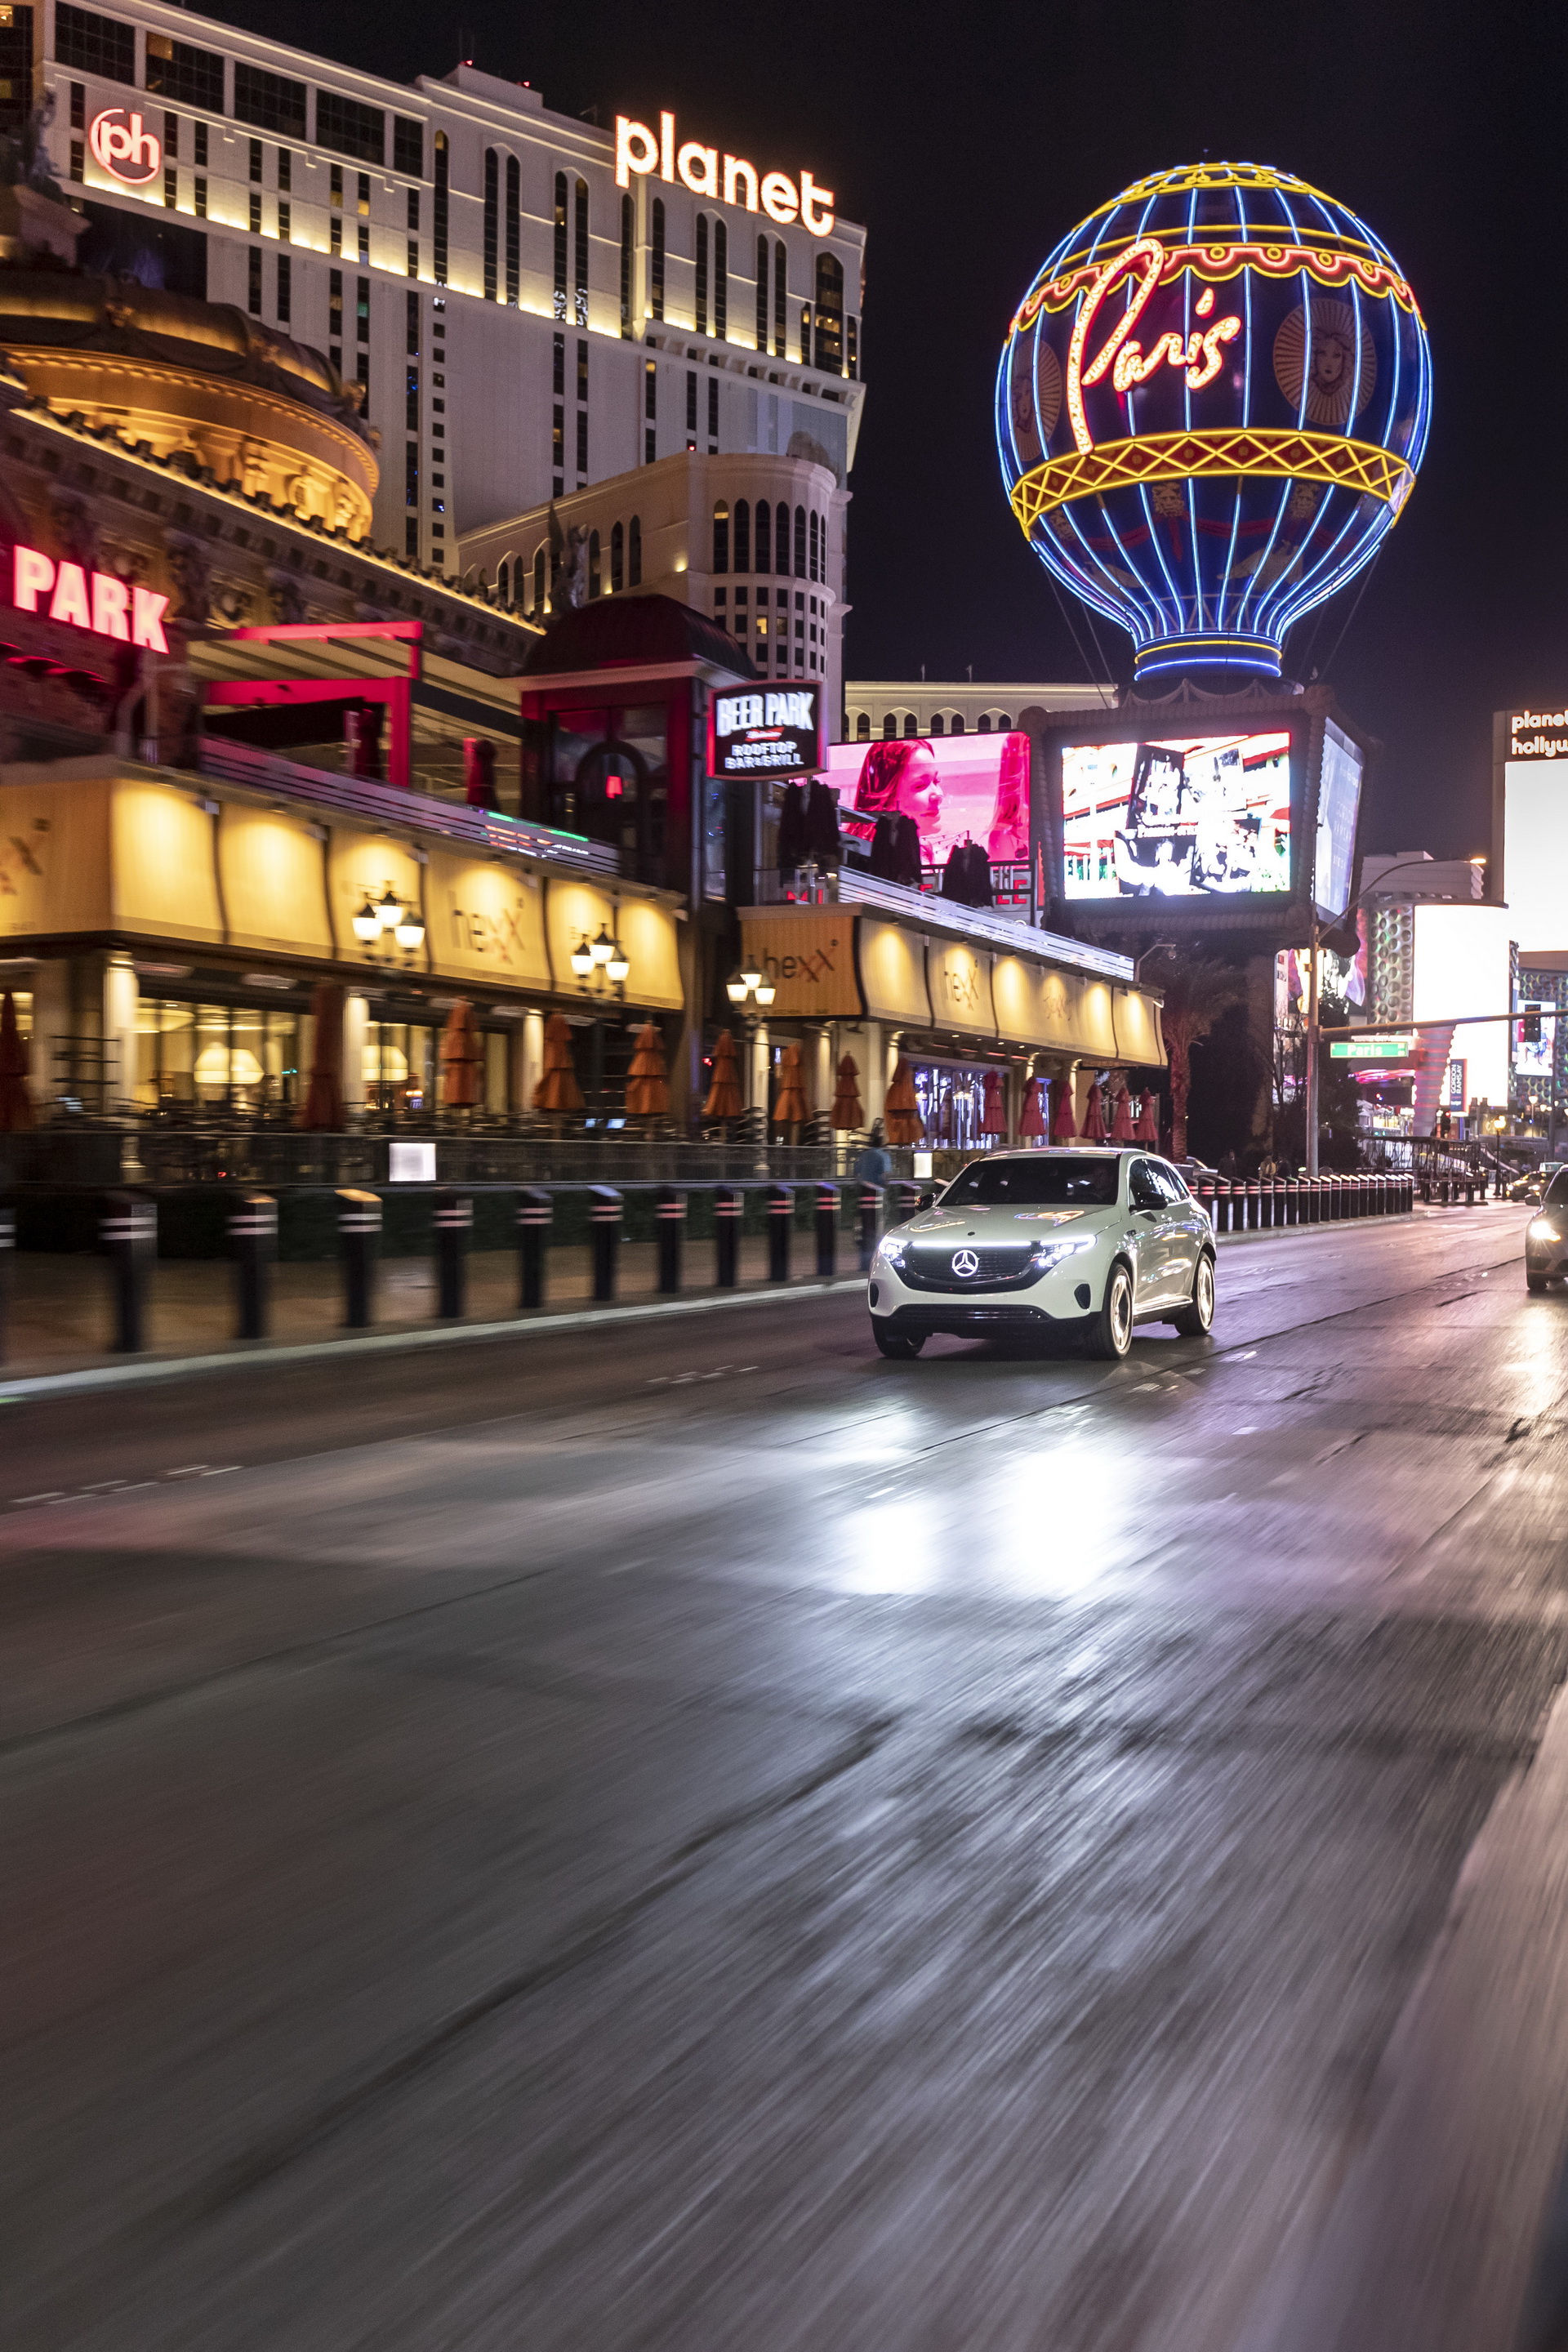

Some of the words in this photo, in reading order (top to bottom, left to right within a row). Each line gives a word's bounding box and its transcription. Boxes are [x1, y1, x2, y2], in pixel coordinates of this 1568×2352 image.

[100, 113, 161, 170] ph
[615, 110, 835, 238] planet
[1067, 238, 1241, 457] Paris
[14, 544, 171, 655] PARK
[716, 694, 764, 737] BEER
[764, 692, 814, 730] PARK
[732, 741, 798, 756] ROOFTOP
[1347, 1044, 1383, 1056] Paris
